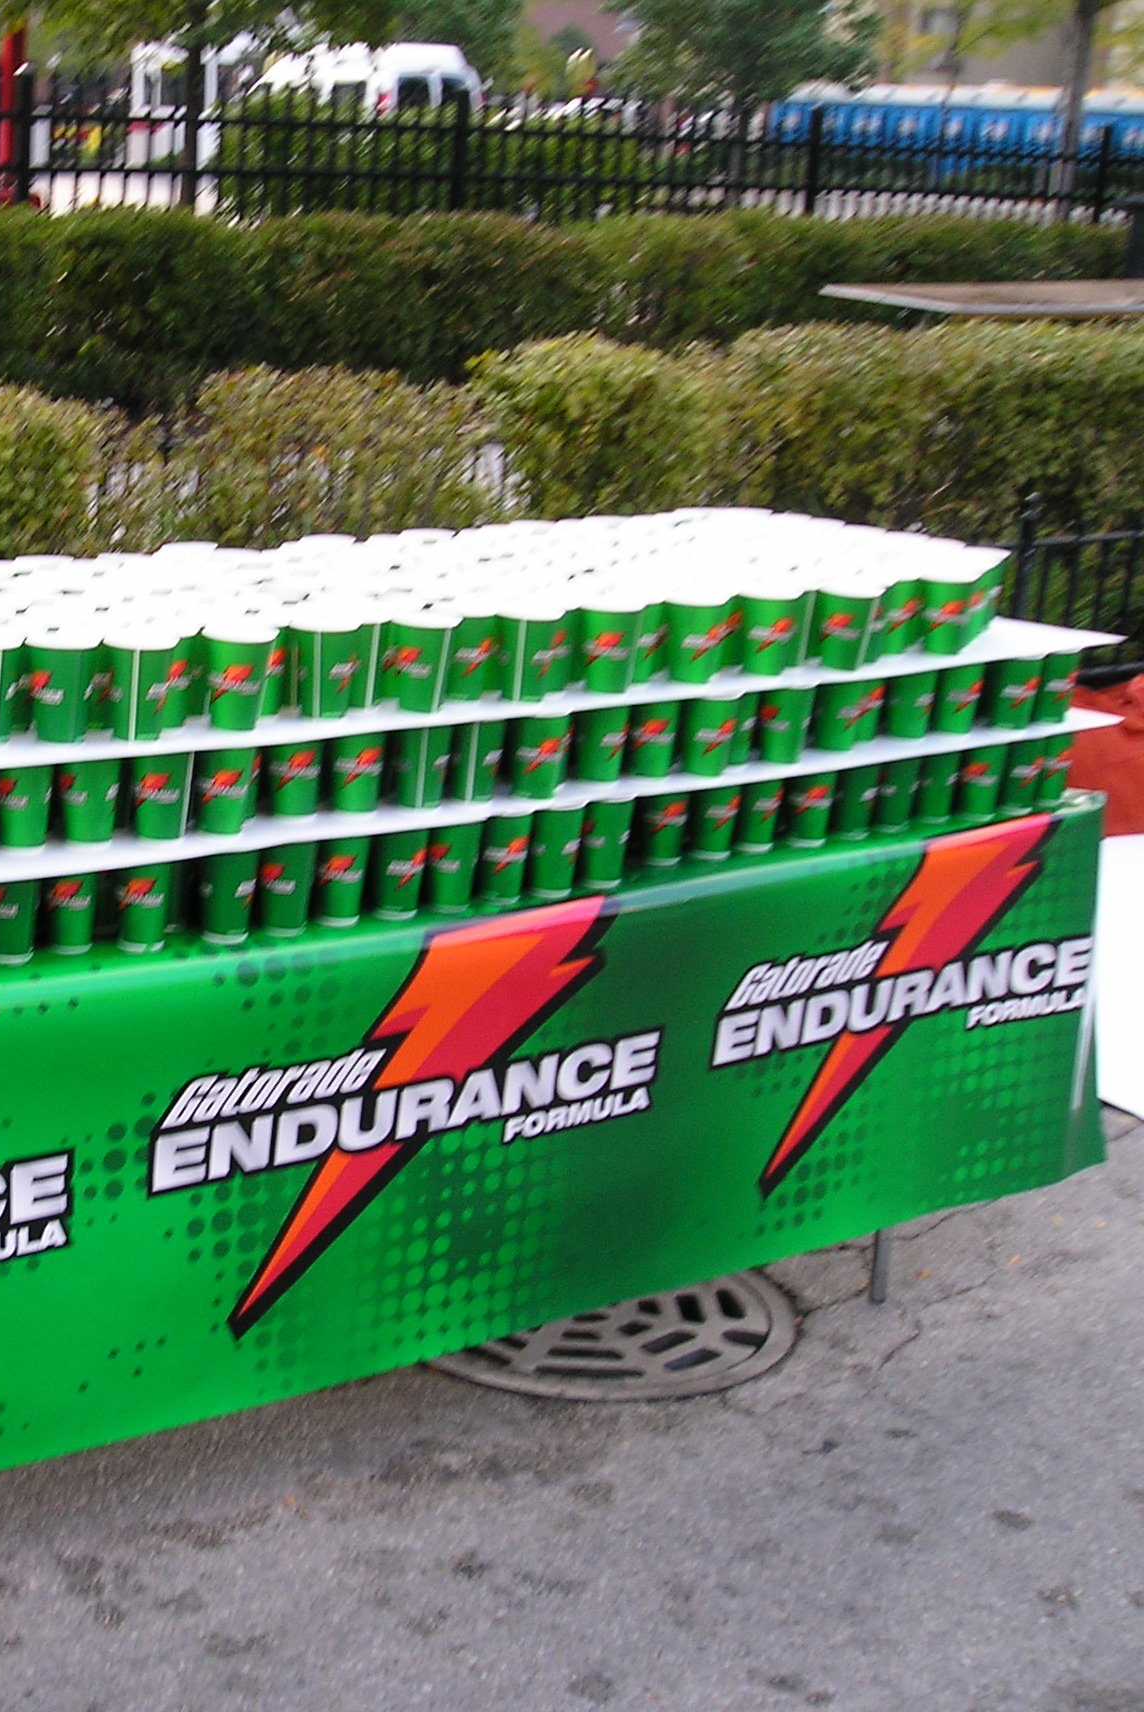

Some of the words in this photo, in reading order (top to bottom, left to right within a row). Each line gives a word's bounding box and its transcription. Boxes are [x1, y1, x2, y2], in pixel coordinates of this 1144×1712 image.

[713, 936, 1094, 1067] ENDURANCE
[724, 939, 890, 1011] Gatorade
[965, 986, 1089, 1031] FORMULA
[152, 1031, 662, 1193] ENDURANCE
[160, 1047, 387, 1129] Gatorade
[501, 1087, 650, 1143] FORMULA
